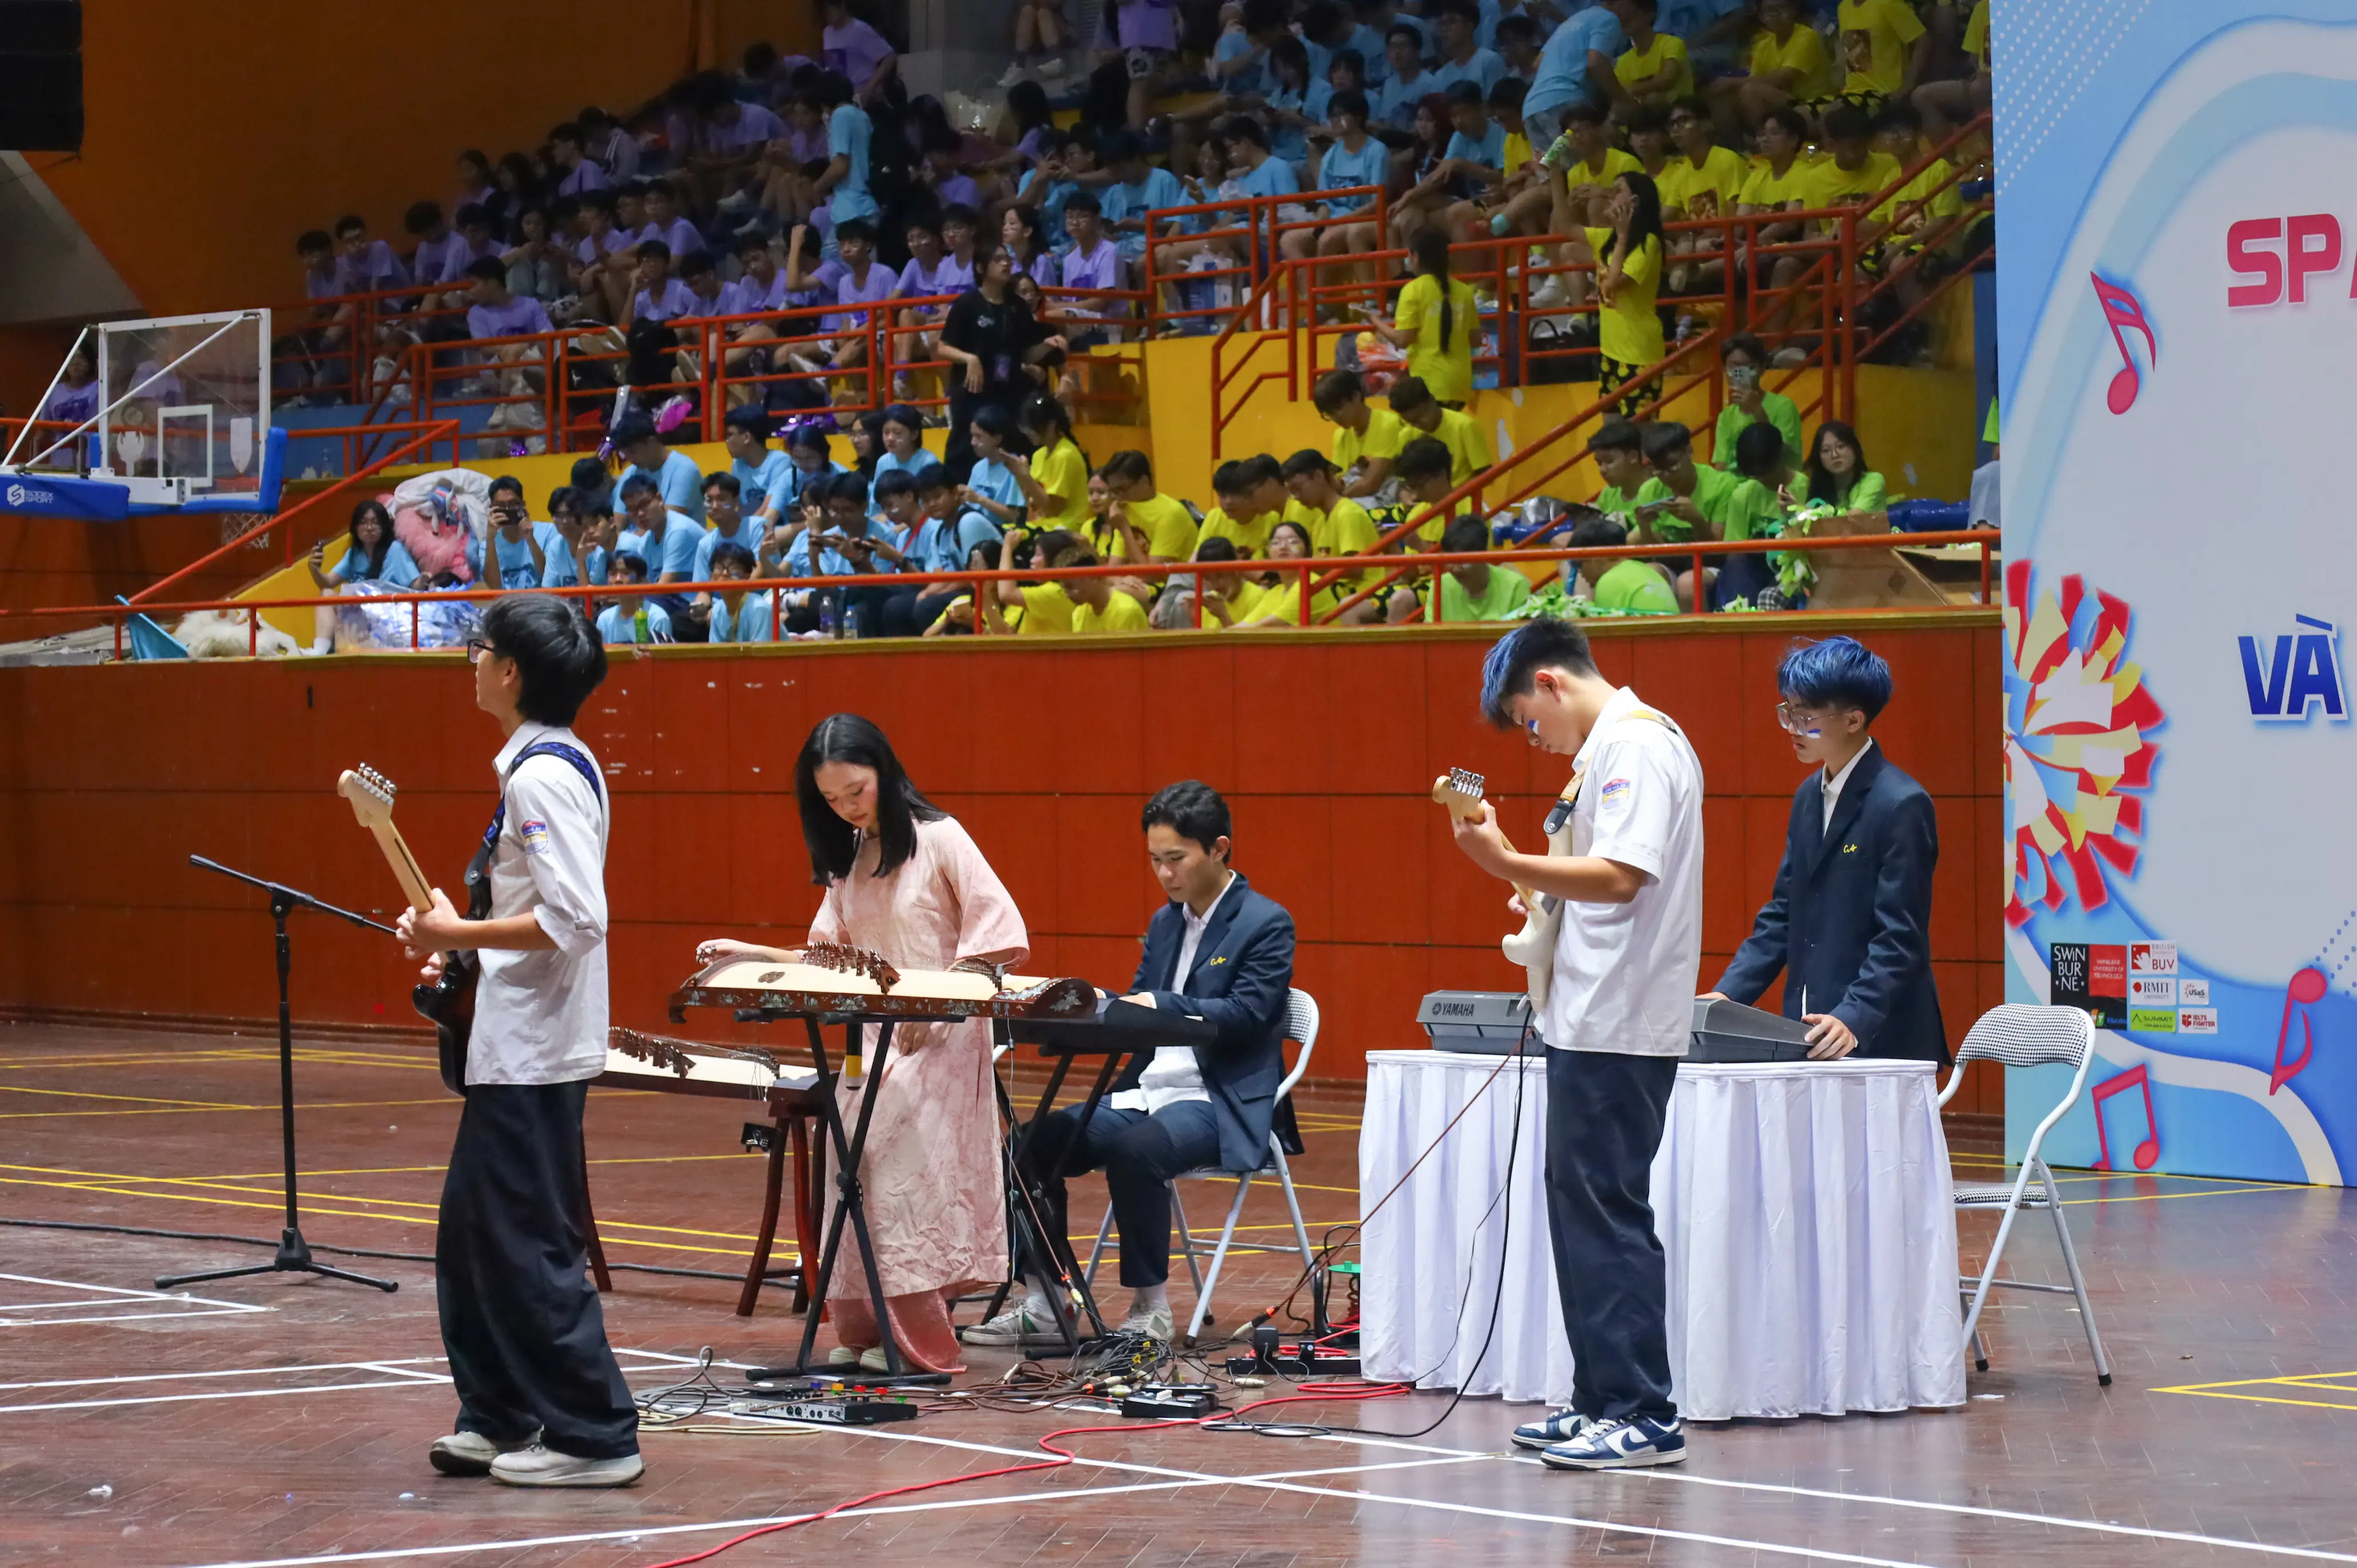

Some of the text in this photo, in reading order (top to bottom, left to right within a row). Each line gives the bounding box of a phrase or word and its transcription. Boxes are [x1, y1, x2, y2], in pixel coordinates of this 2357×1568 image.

[2238, 613, 2343, 714] VÀ
[2058, 962, 2082, 976] BUR
[2152, 959, 2174, 970] BUV
[2144, 982, 2170, 993] RMIT
[1442, 1003, 1474, 1016] YAMAHA
